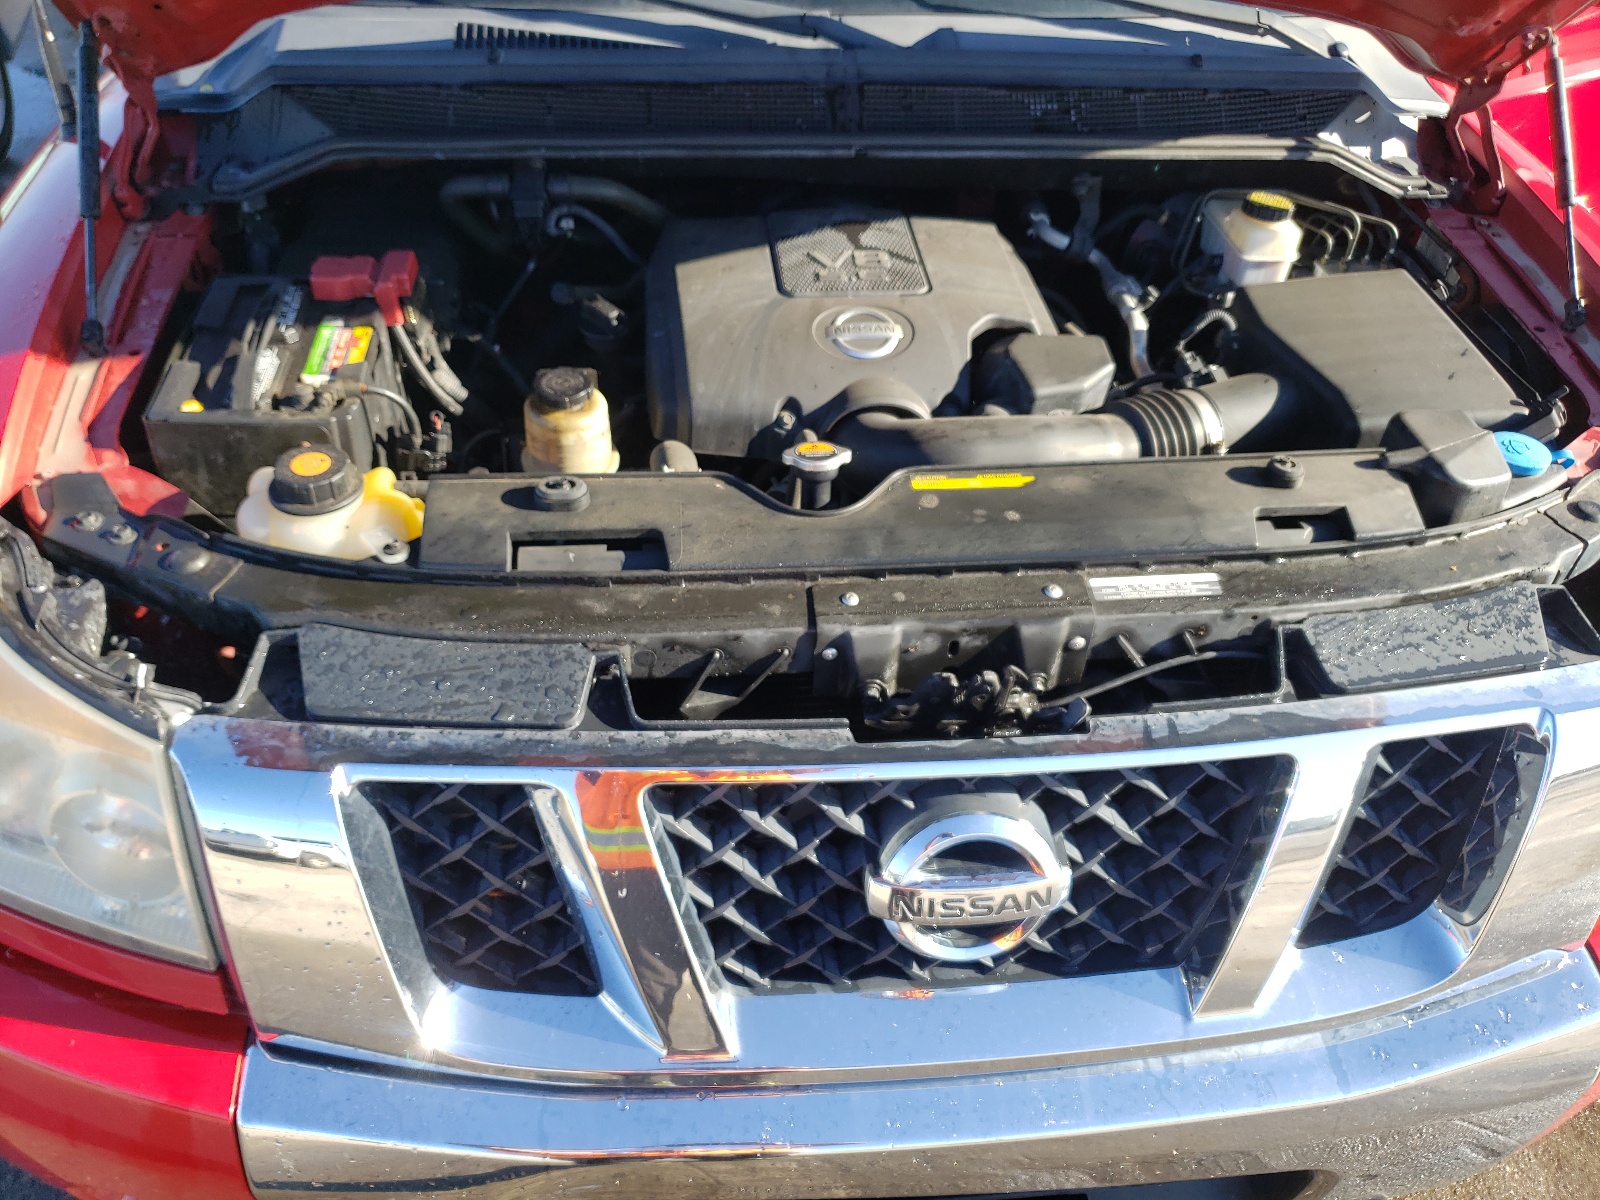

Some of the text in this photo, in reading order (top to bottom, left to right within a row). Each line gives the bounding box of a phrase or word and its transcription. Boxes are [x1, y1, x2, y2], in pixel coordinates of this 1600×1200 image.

[807, 249, 892, 268] V8
[832, 323, 896, 334] NISSAN
[891, 887, 1052, 919] NISSAN
